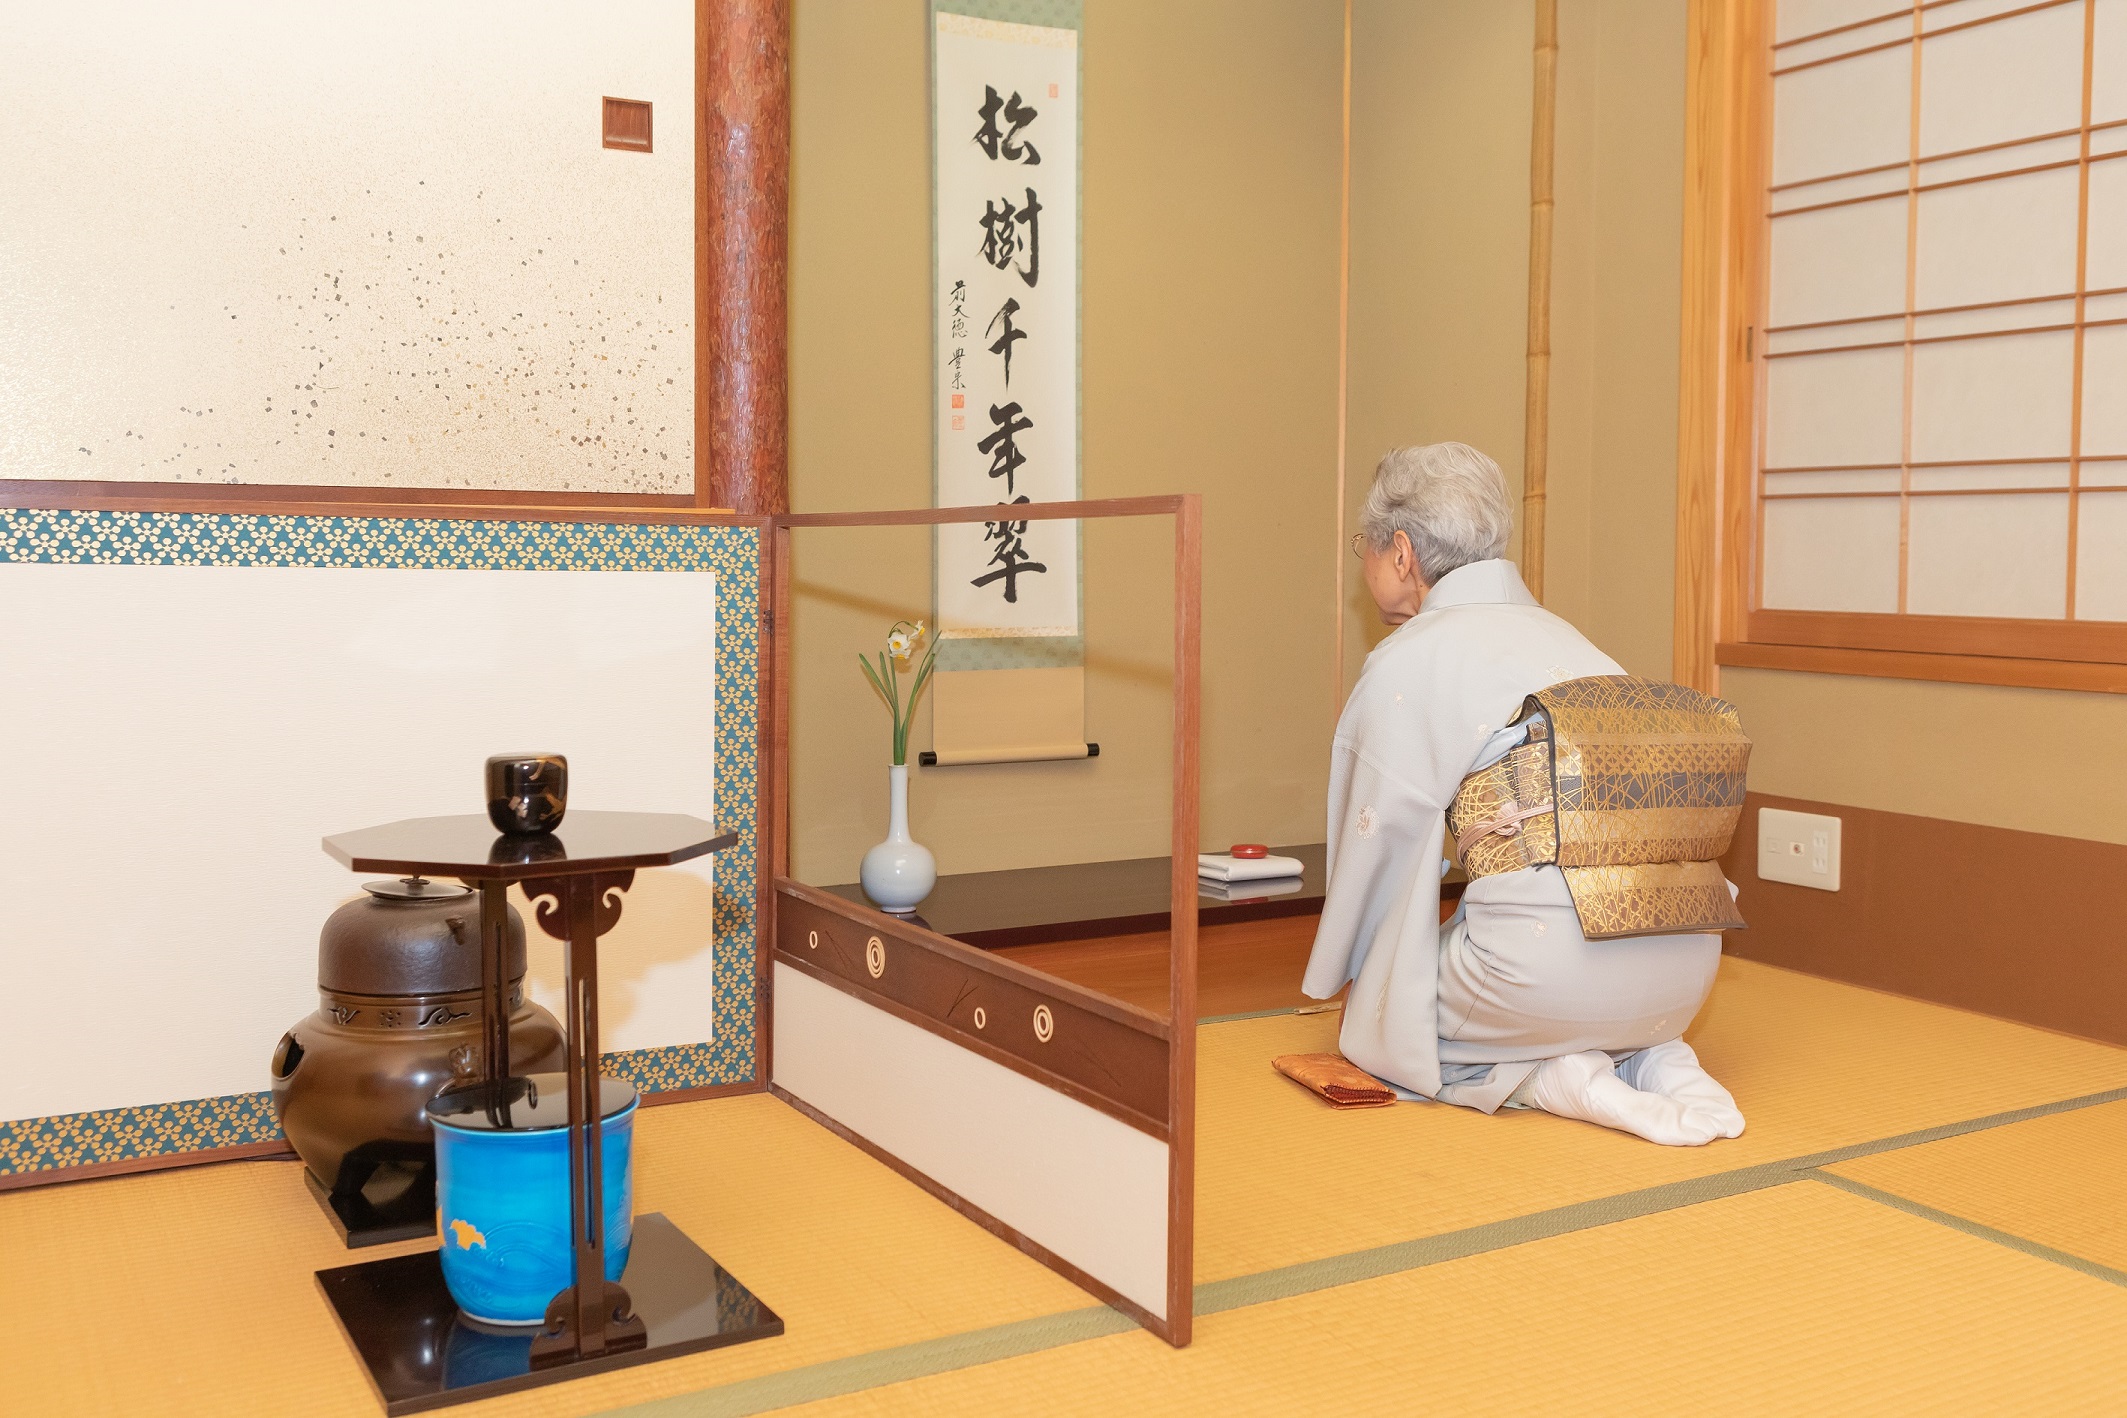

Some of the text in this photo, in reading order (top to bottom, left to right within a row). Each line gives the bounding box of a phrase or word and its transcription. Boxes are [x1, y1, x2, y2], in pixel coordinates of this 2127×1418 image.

[969, 84, 1047, 604] 松樹千年翠
